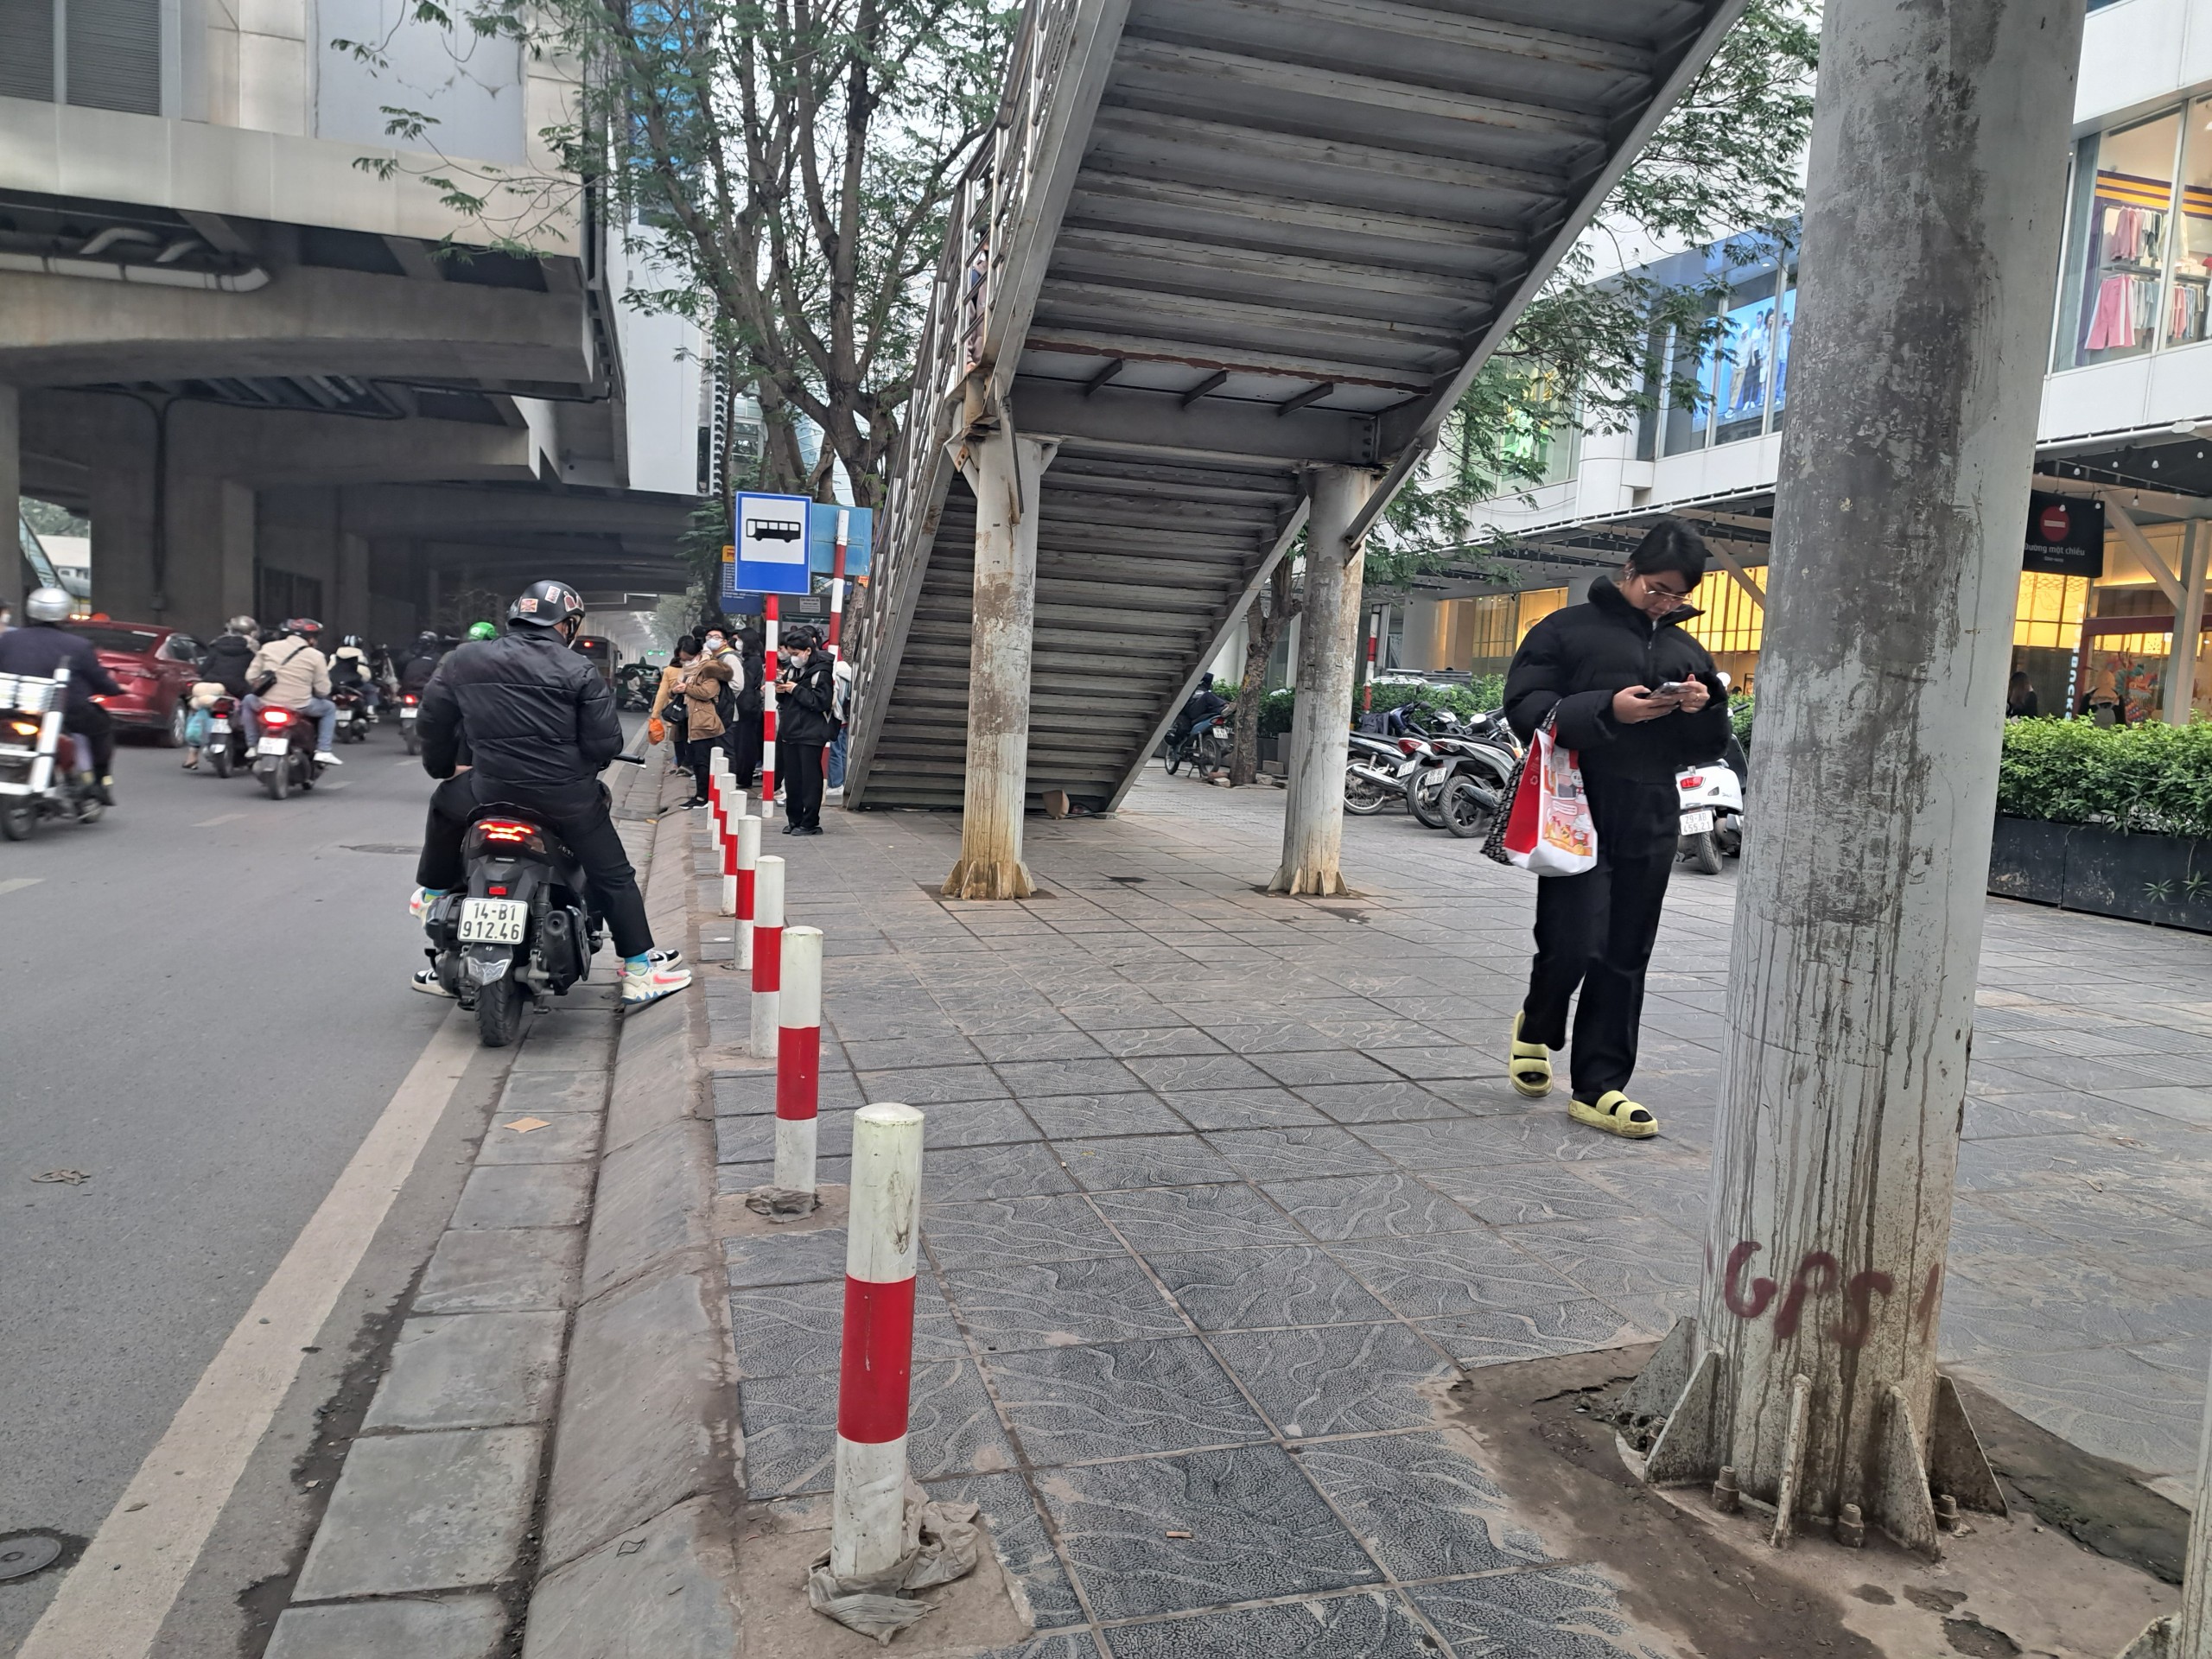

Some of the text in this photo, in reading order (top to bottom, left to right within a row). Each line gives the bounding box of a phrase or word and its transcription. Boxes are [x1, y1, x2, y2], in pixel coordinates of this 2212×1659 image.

[1684, 822, 1711, 832] 455.21
[474, 903, 516, 920] 14-B1
[462, 921, 520, 940] 912.46
